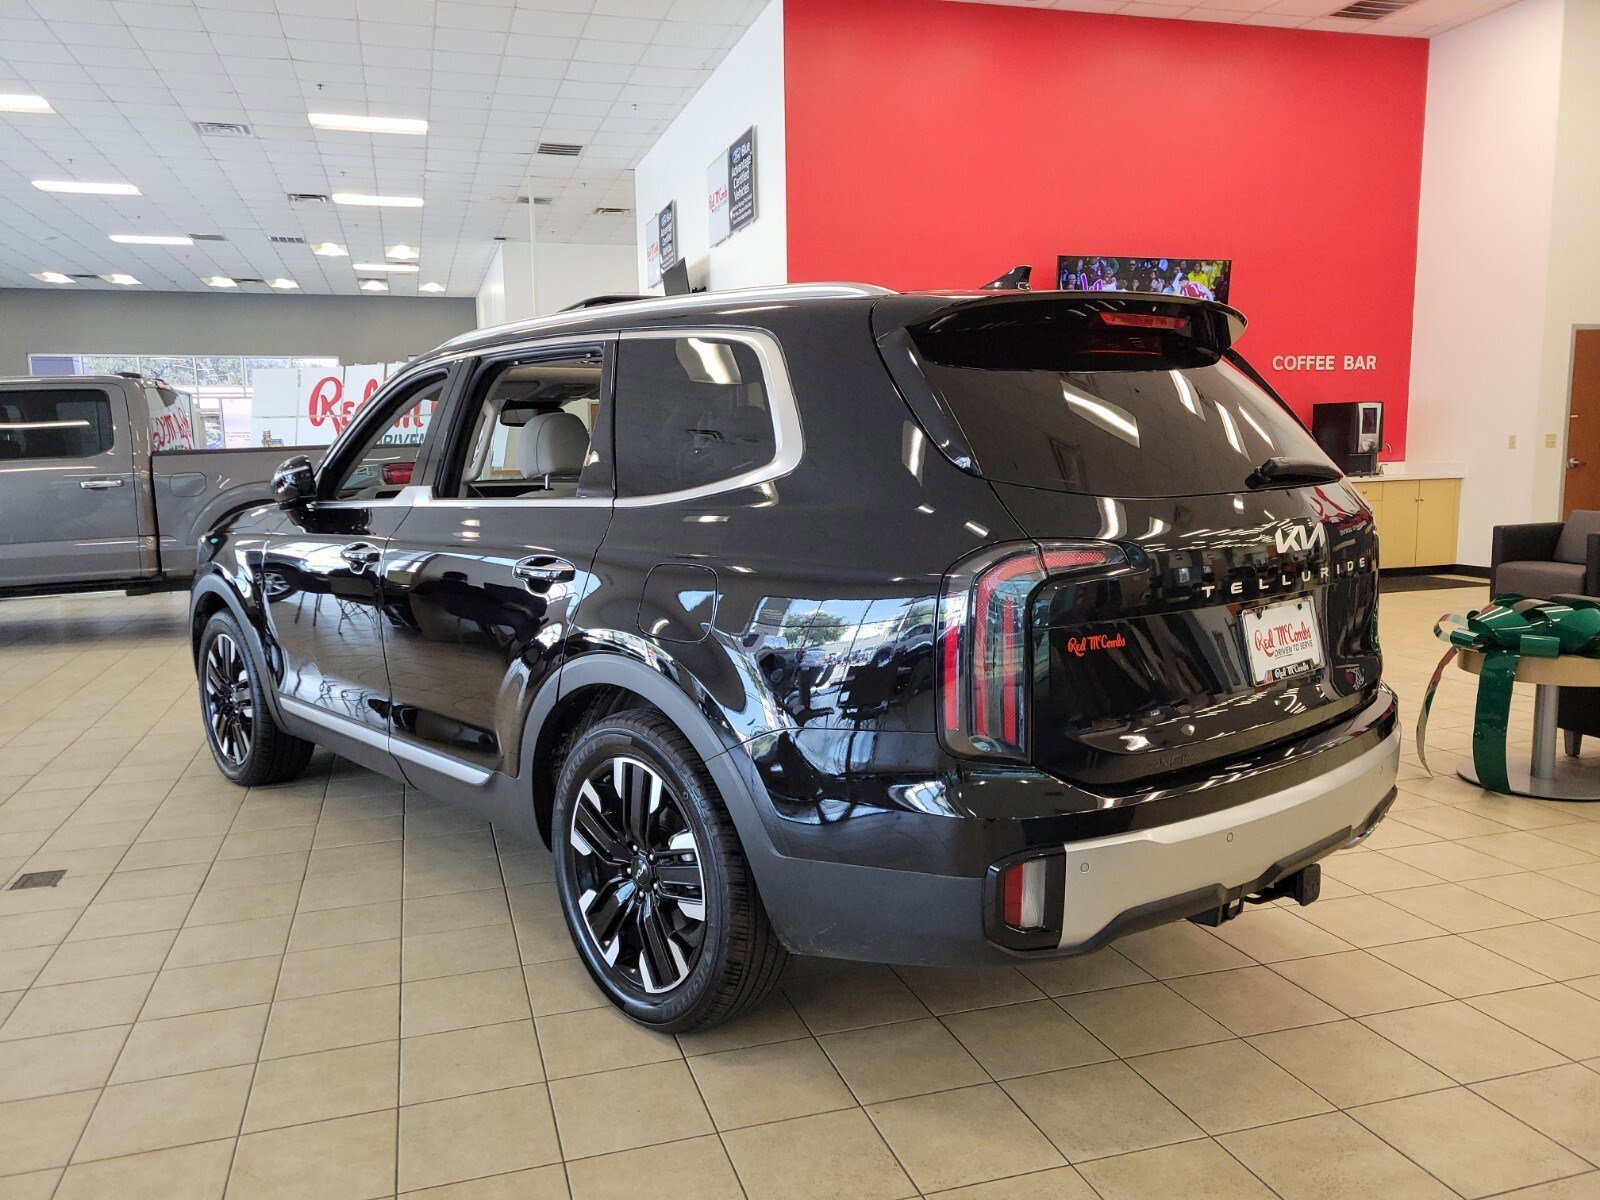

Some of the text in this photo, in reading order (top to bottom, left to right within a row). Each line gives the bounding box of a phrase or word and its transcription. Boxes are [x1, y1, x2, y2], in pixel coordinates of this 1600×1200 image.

[1272, 355, 1377, 371] COFFEE BAR
[380, 433, 425, 444] RIVEN
[1275, 522, 1326, 554] KIA
[1201, 557, 1366, 598] TELLURIDE
[1067, 637, 1087, 657] Red
[1254, 628, 1276, 658] Red
[1274, 640, 1314, 658] DRIVEN TO SERVE
